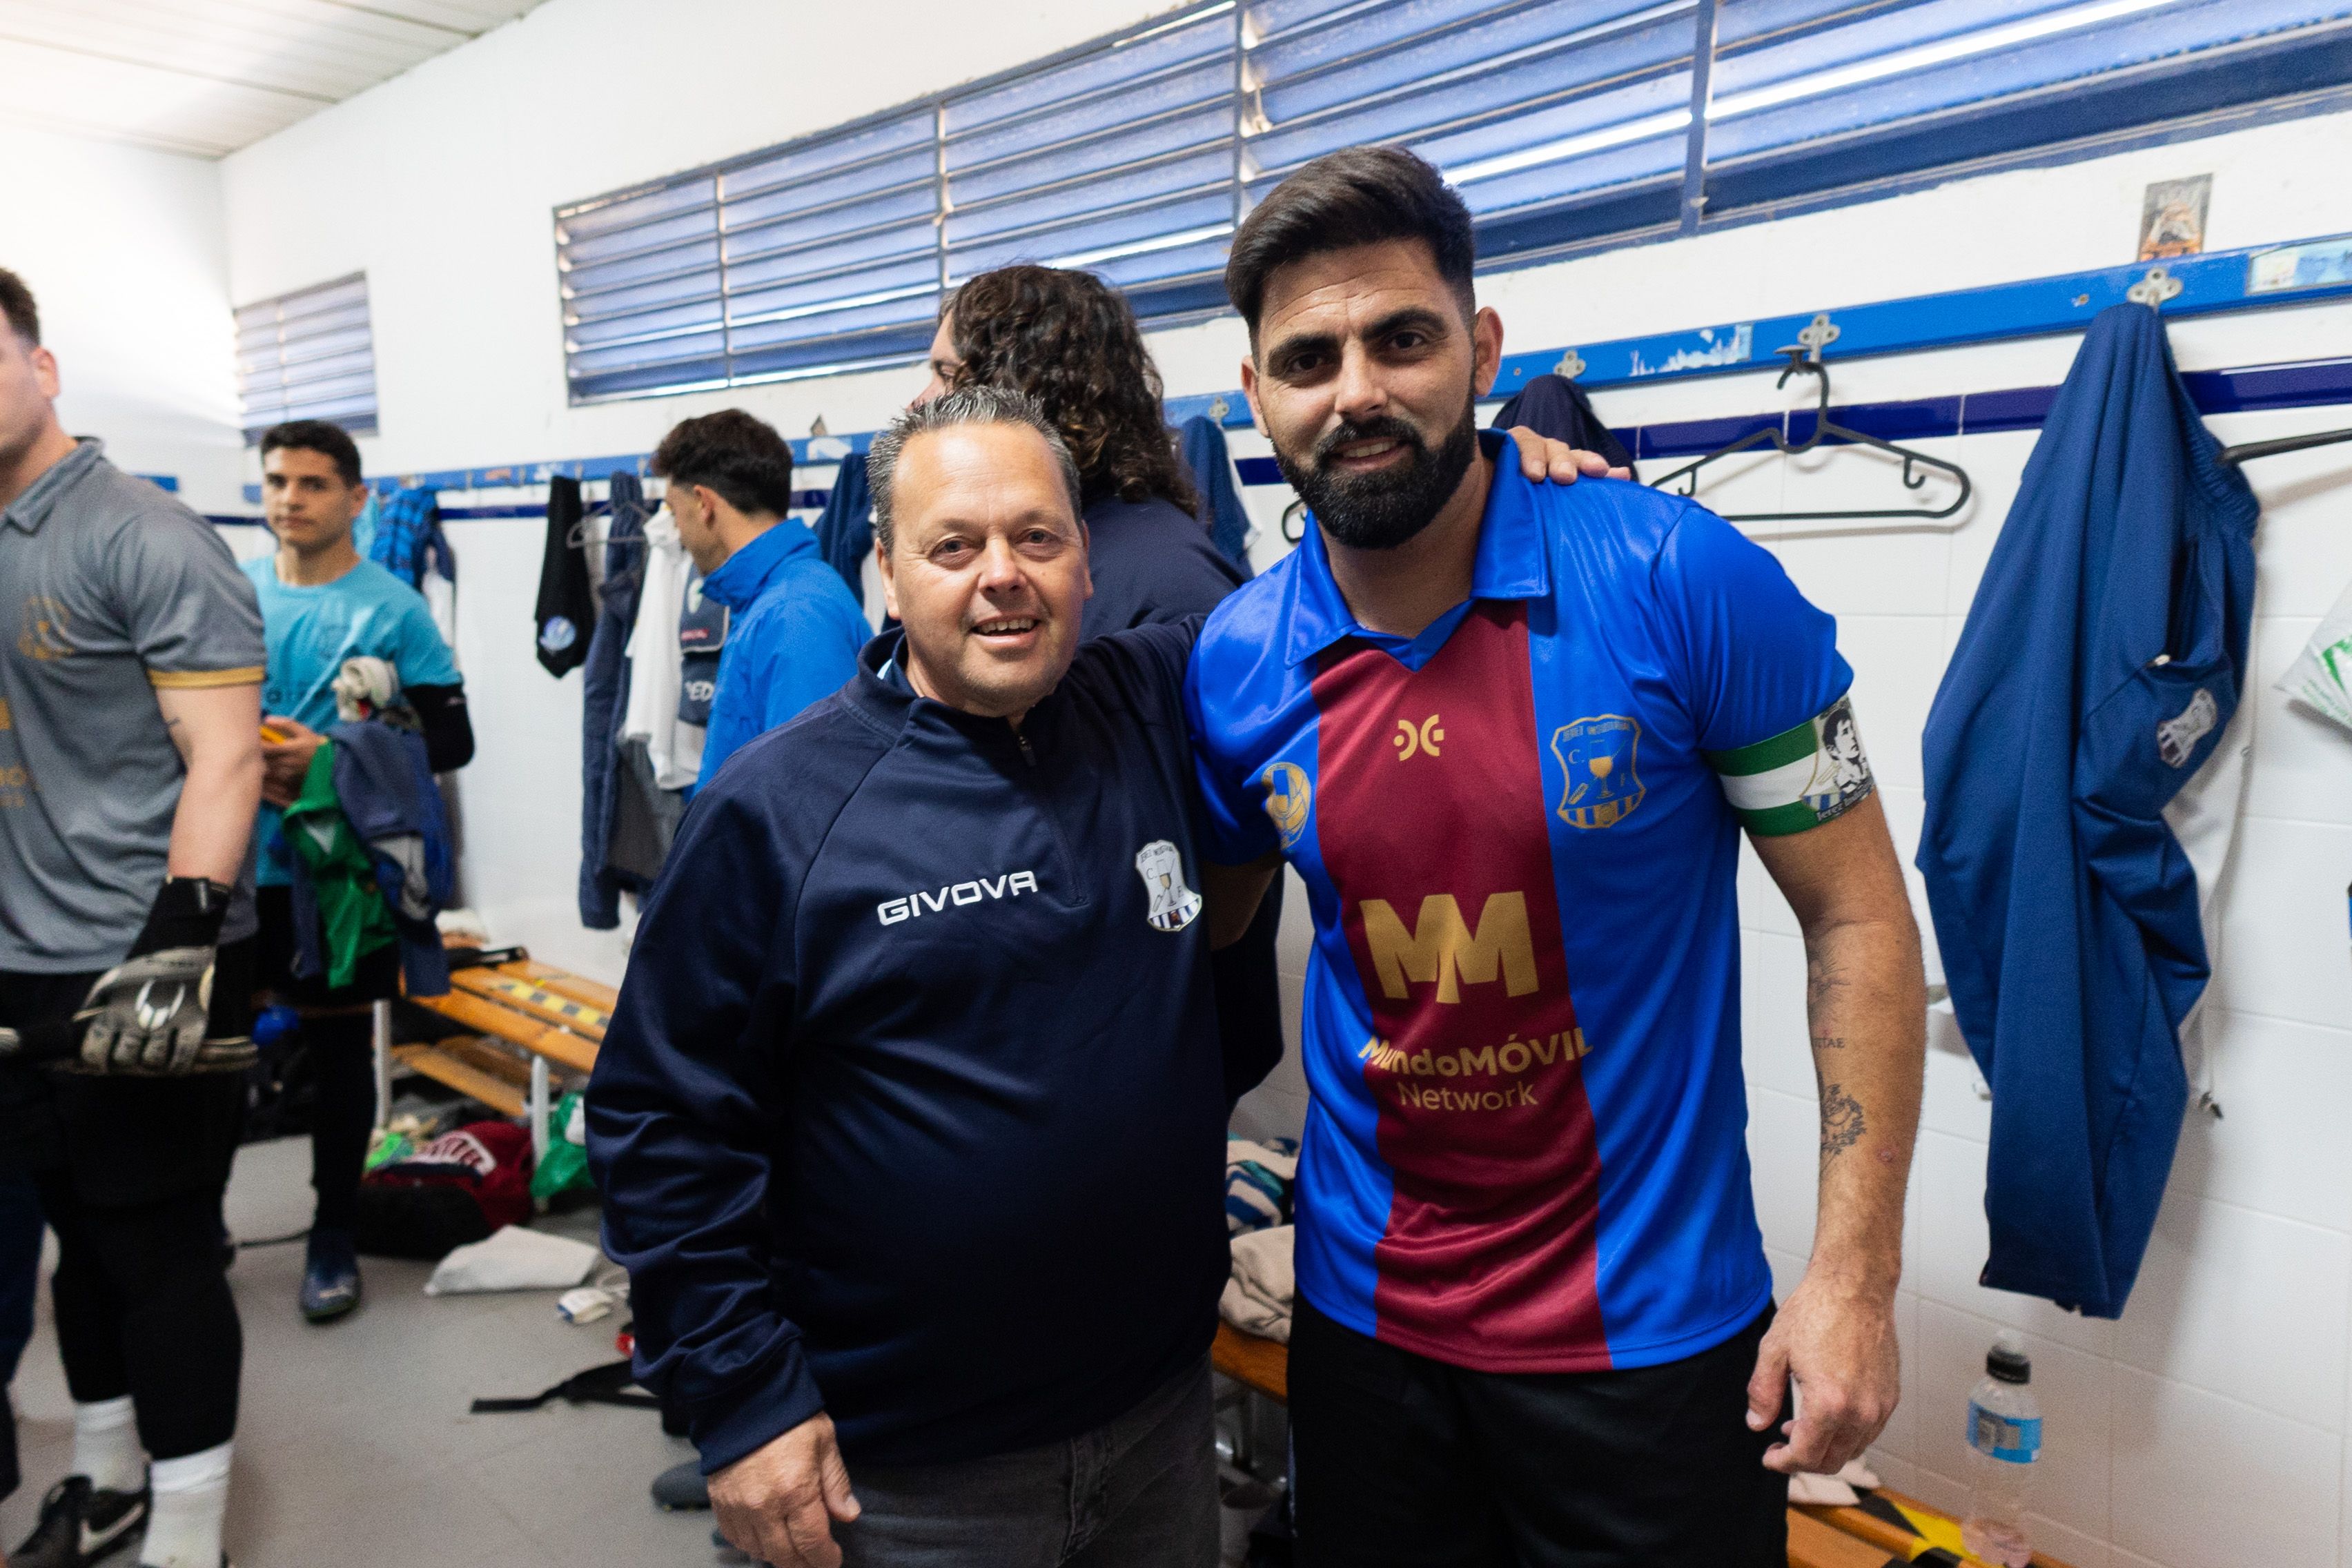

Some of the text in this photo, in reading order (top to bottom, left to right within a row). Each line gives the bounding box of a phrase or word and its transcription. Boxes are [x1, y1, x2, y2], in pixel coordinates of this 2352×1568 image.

[877, 870, 1039, 926] GIVOVA
[1358, 890, 1540, 1004] MM
[1398, 1081, 1540, 1110] Network
